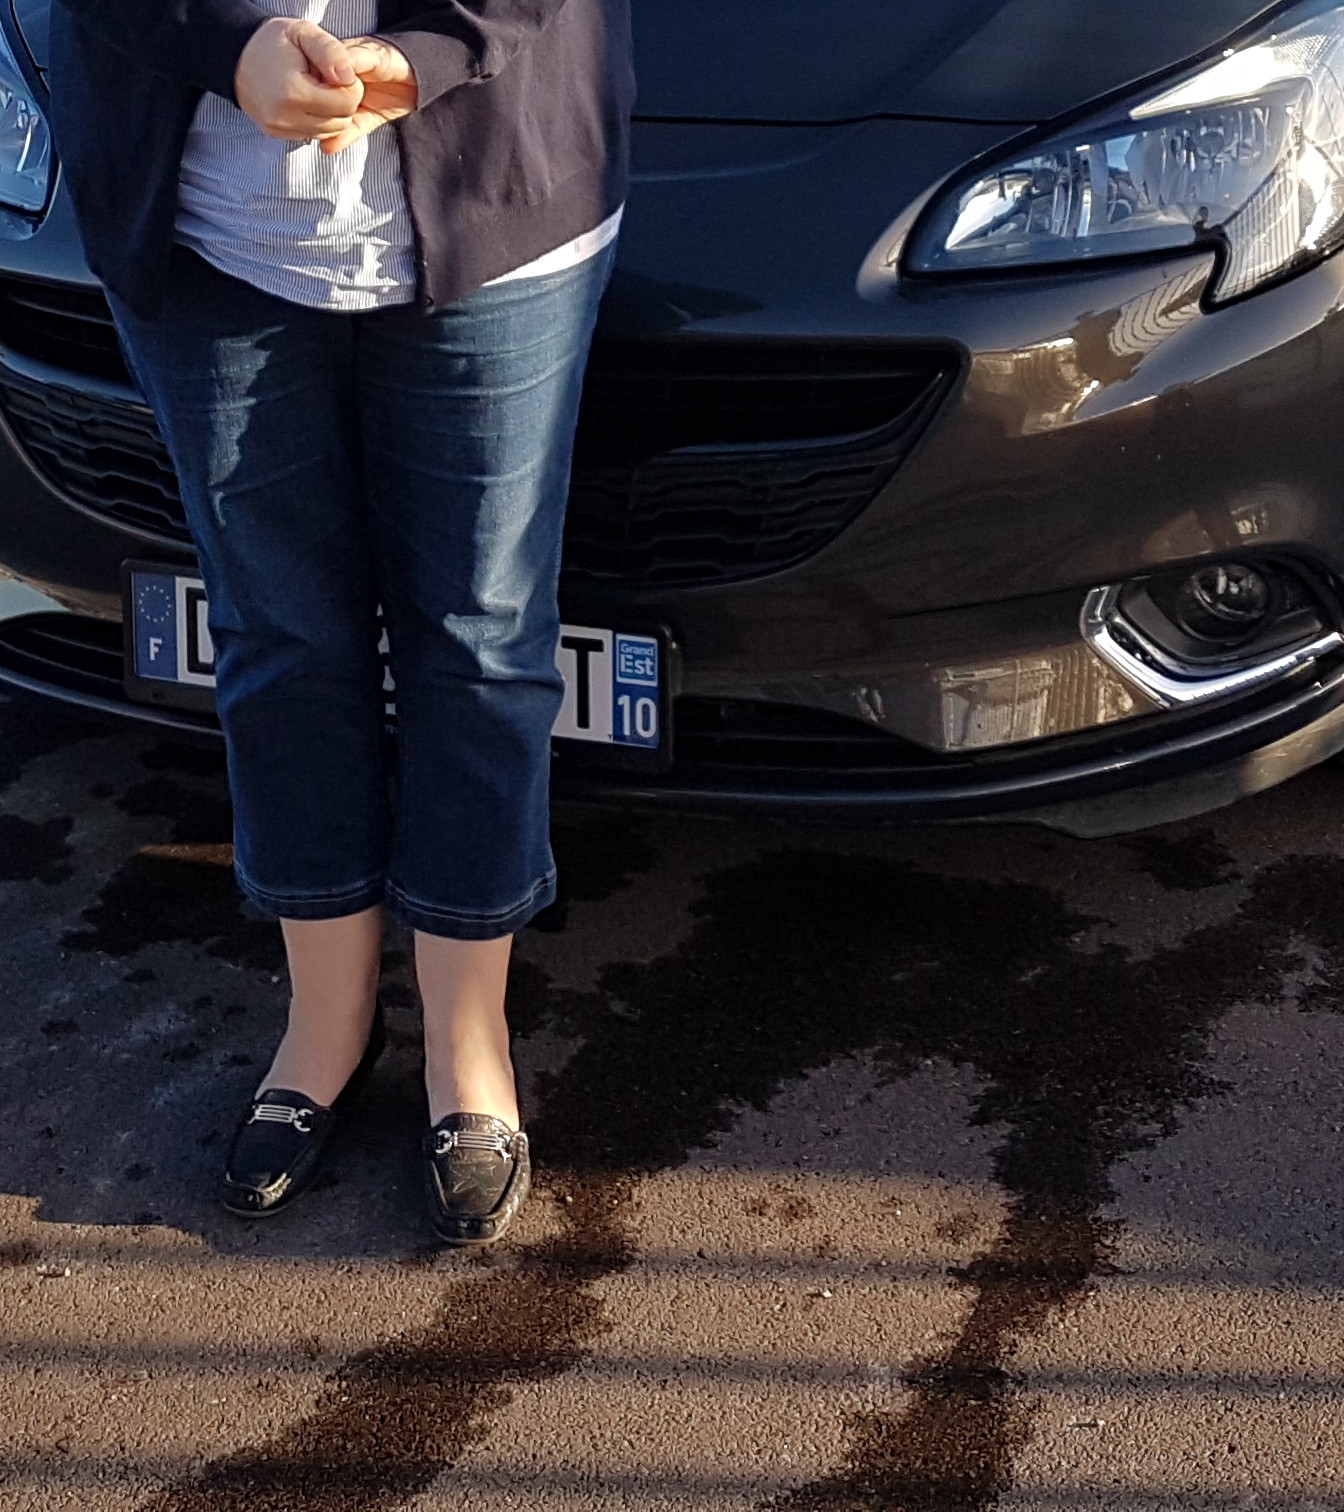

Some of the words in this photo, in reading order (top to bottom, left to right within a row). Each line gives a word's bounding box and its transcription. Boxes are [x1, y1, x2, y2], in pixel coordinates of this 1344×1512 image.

[149, 637, 163, 661] F
[620, 643, 655, 656] Grand
[620, 654, 654, 676] Est
[617, 694, 657, 739] 10
